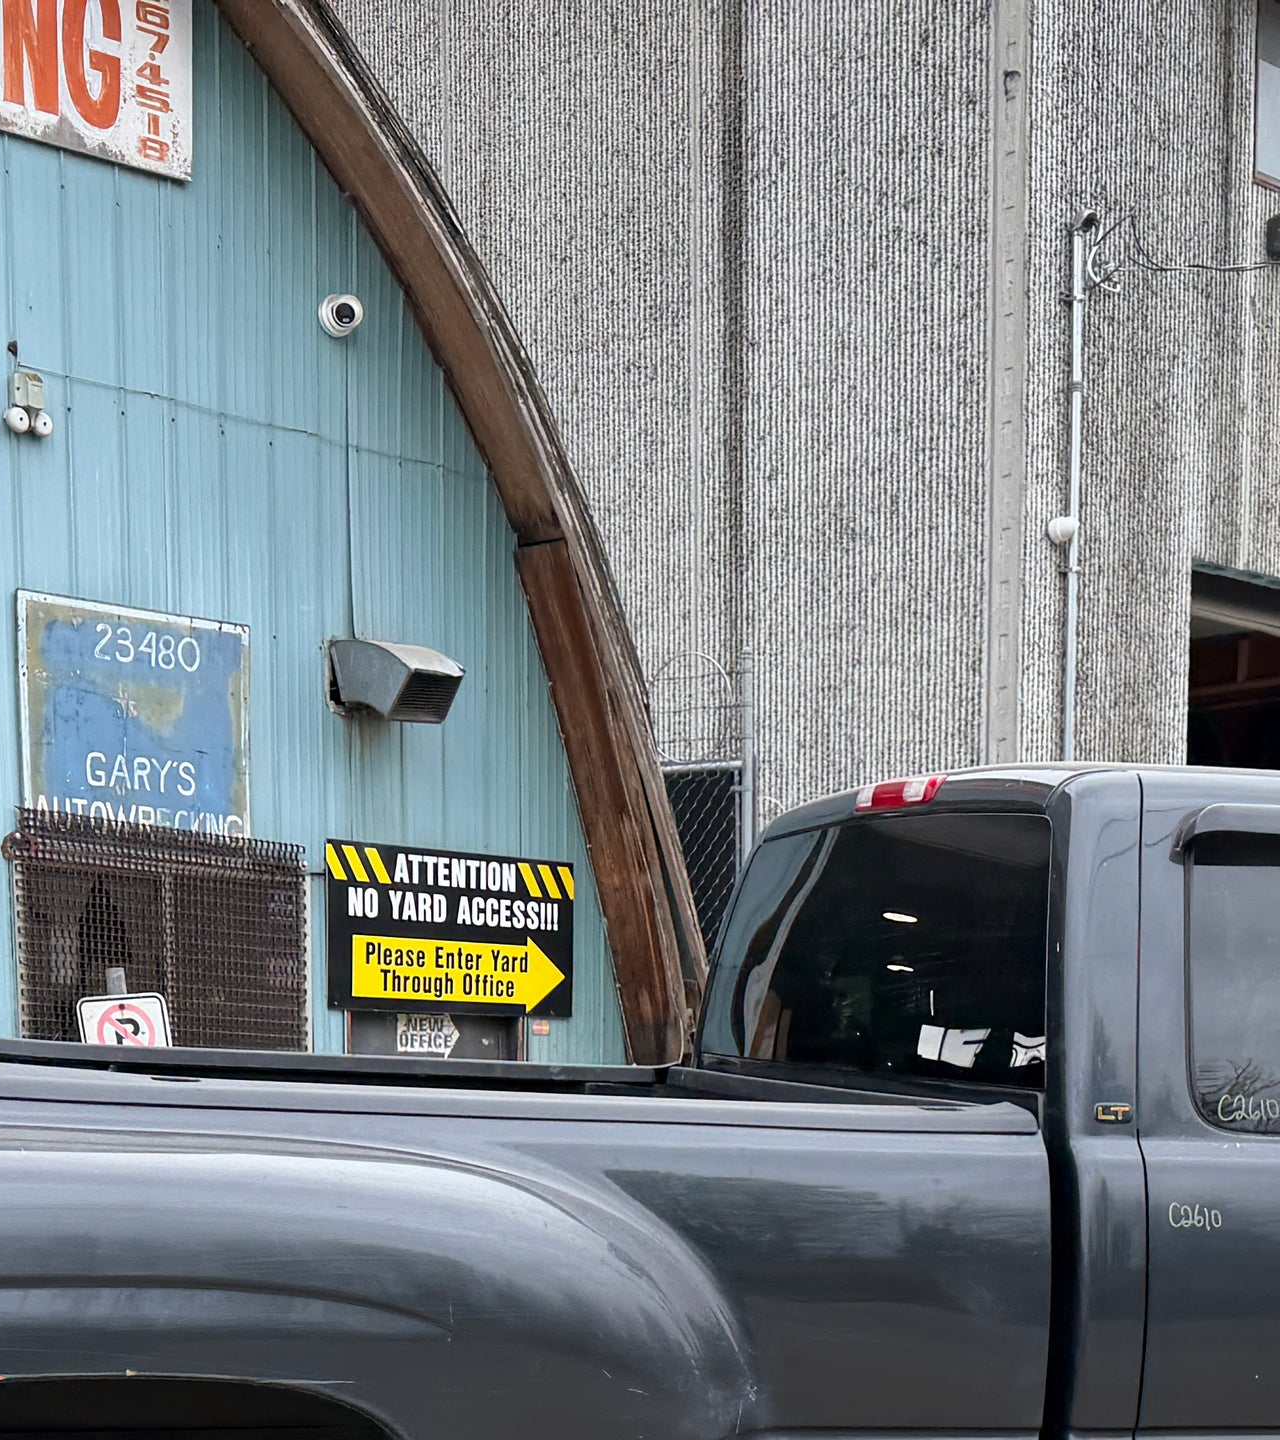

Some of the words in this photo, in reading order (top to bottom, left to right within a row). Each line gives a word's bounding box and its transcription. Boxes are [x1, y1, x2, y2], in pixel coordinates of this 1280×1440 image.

[94, 622, 201, 672] 23480
[86, 751, 196, 796] GARY'S
[393, 853, 517, 893] ATTENTION
[347, 886, 379, 918] NO
[388, 890, 447, 923] YARD
[457, 896, 559, 931] ACCESS!!!
[365, 942, 425, 967] Please
[435, 946, 483, 971] Enter
[491, 949, 528, 973] Yard
[380, 969, 454, 998] Through
[463, 974, 515, 998] Office
[406, 1018, 444, 1032] NEW
[399, 1031, 453, 1049] OFFICE
[1097, 1106, 1130, 1120] LT
[1218, 1094, 1279, 1121] C2610
[1168, 1202, 1222, 1231] C2610
